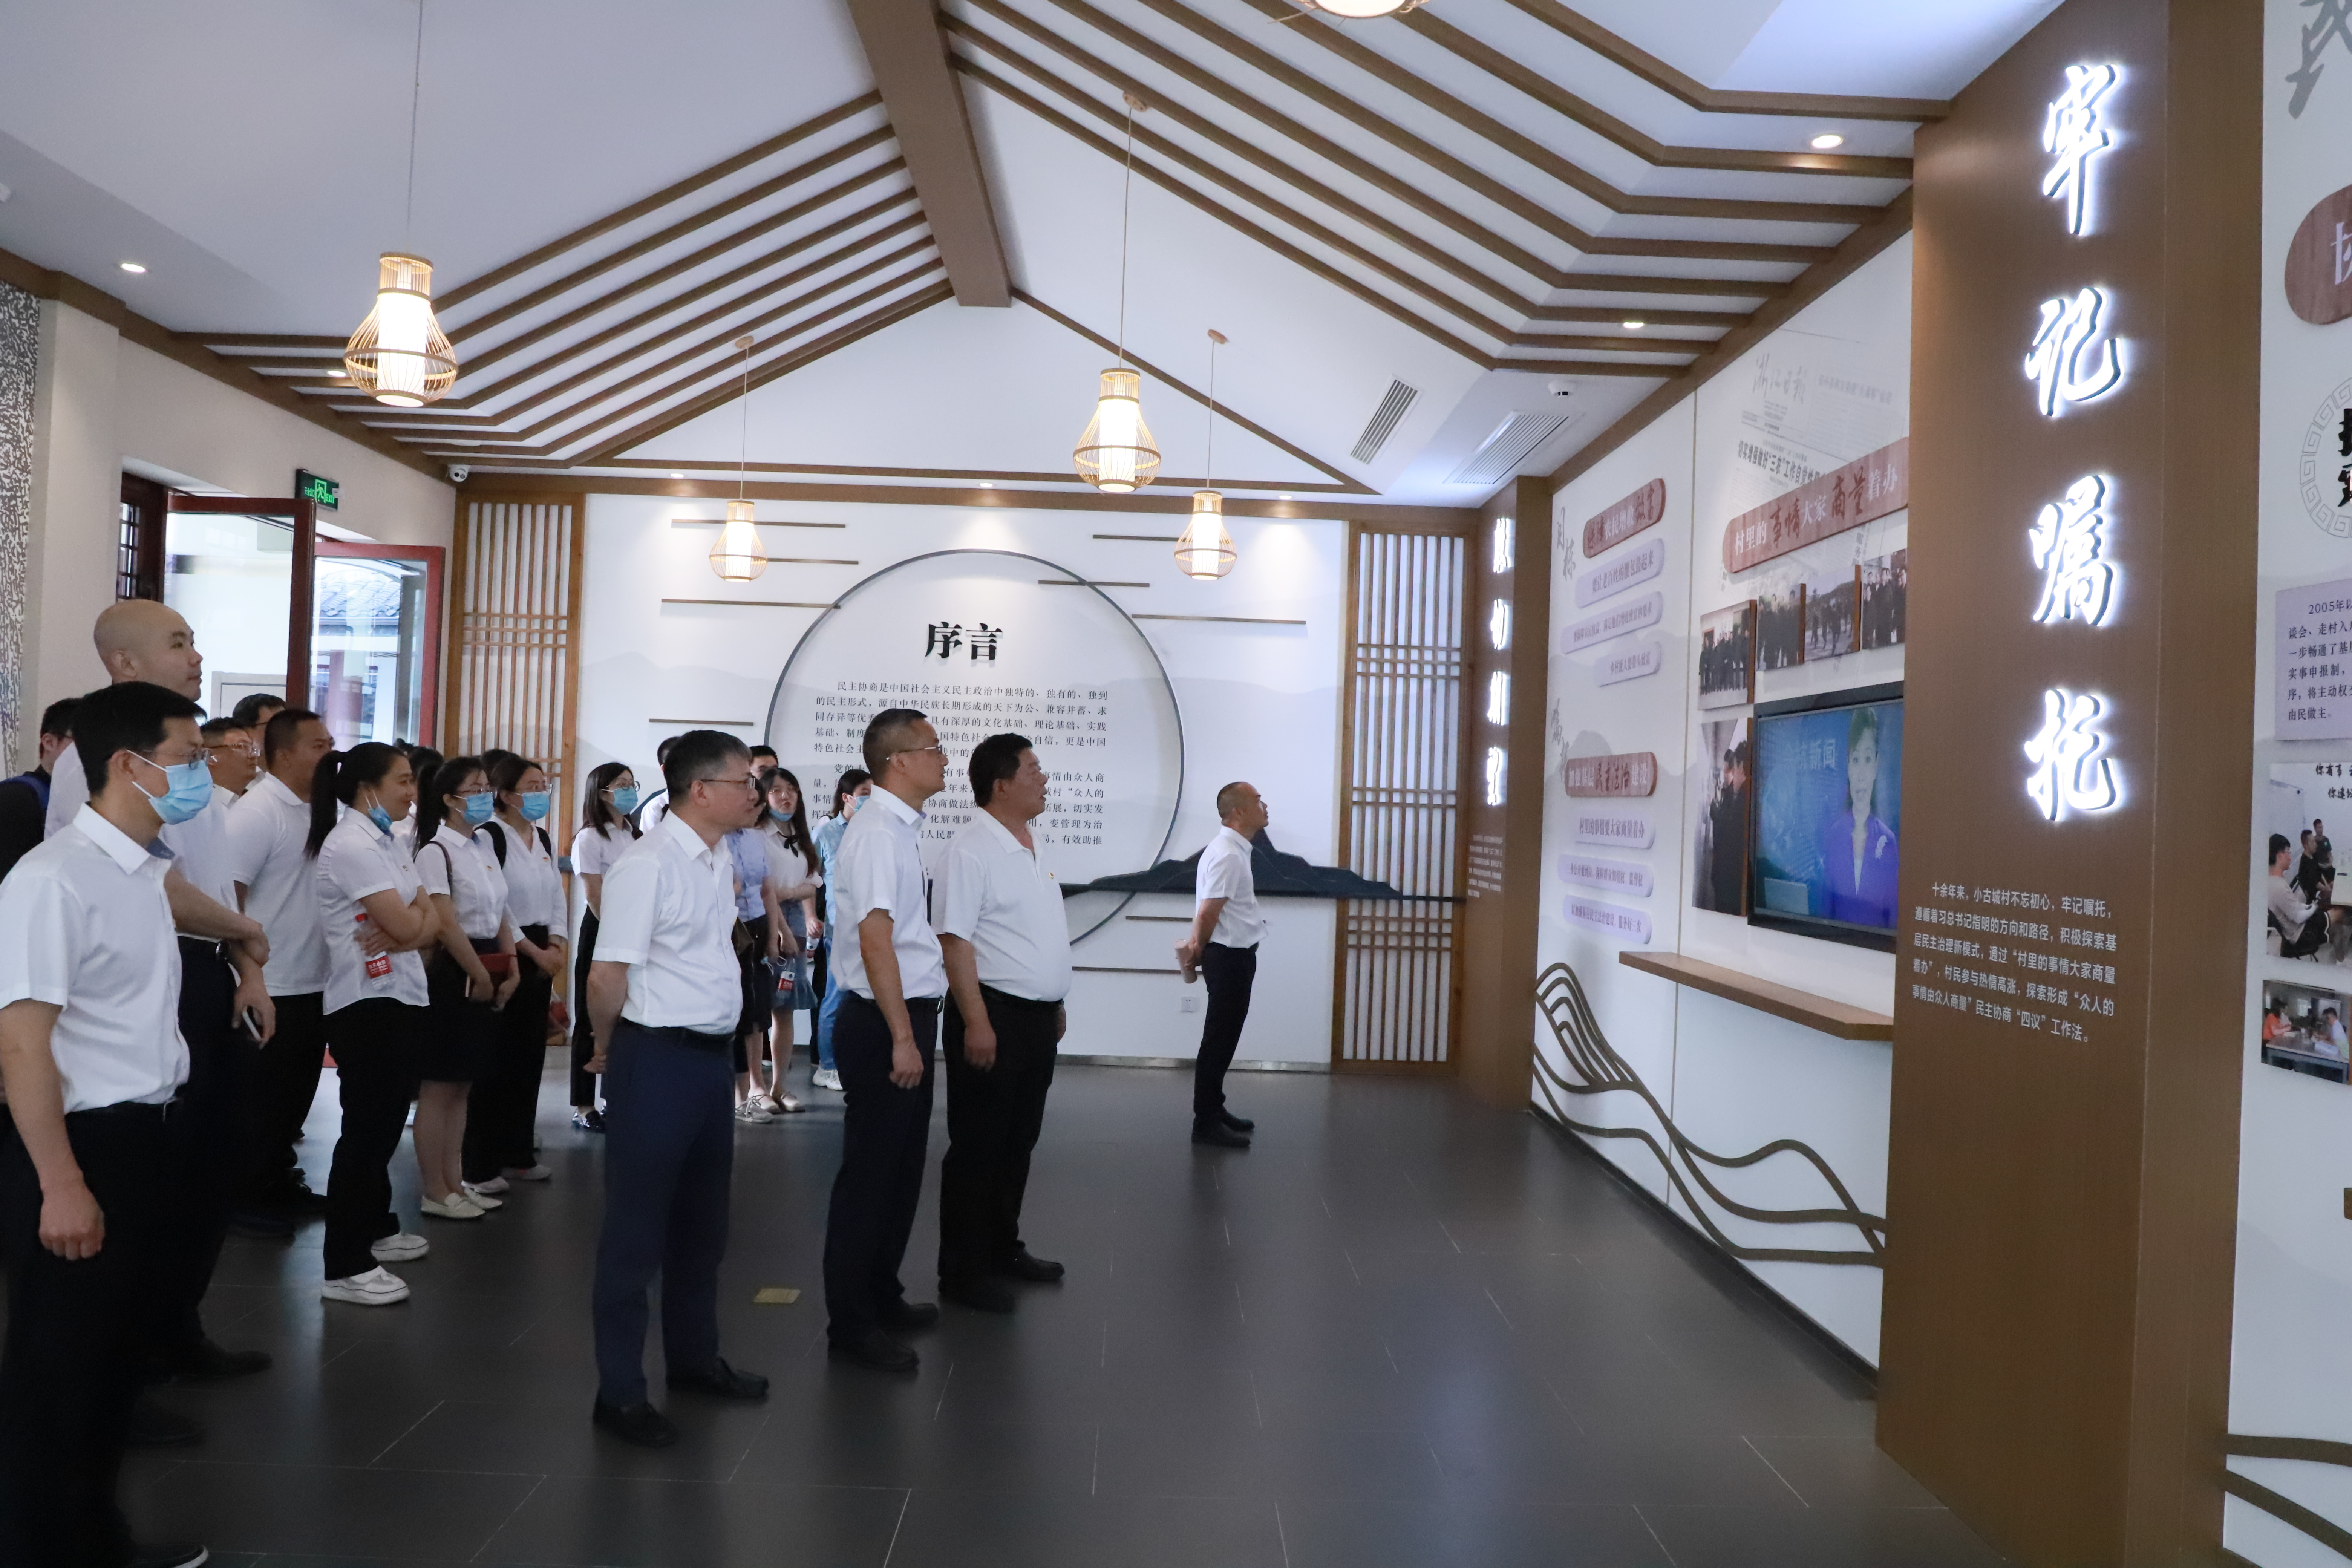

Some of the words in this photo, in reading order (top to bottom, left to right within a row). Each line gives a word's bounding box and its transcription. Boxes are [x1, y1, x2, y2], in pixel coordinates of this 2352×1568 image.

[2024, 63, 2124, 823] 牢记嘱托
[326, 493, 335, 504] EXIT
[1735, 464, 1898, 556] 村里的事情大家商量着办
[925, 621, 1003, 660] 序言
[2289, 641, 2352, 659] 一步畅通了基
[816, 696, 1107, 716] 的民主形式，源自中华民族长期形成的天下为公、兼容并蓄、求
[838, 681, 1107, 700] 民主协商是中国社会主义民主政治中独特的、独有的、独到
[1568, 758, 1647, 793] 加强基层民主法治建设
[1579, 817, 1645, 838] 村里的事情要大家商量着办
[1932, 882, 2112, 918] 十余年来，小古城村不忘初心，牢记嘱托，
[1915, 906, 2117, 951] 遵循着习总书记指明的方向和路径，积极探索基
[1914, 933, 2115, 985] 层民主治理新模式，通过“村里的事情大家商量
[1913, 958, 2114, 1017] 着办”，村民参与热情高涨，探索形成“众人的
[1912, 984, 2088, 1043] 事情由众人商量”民主协商“四议”工作法。
